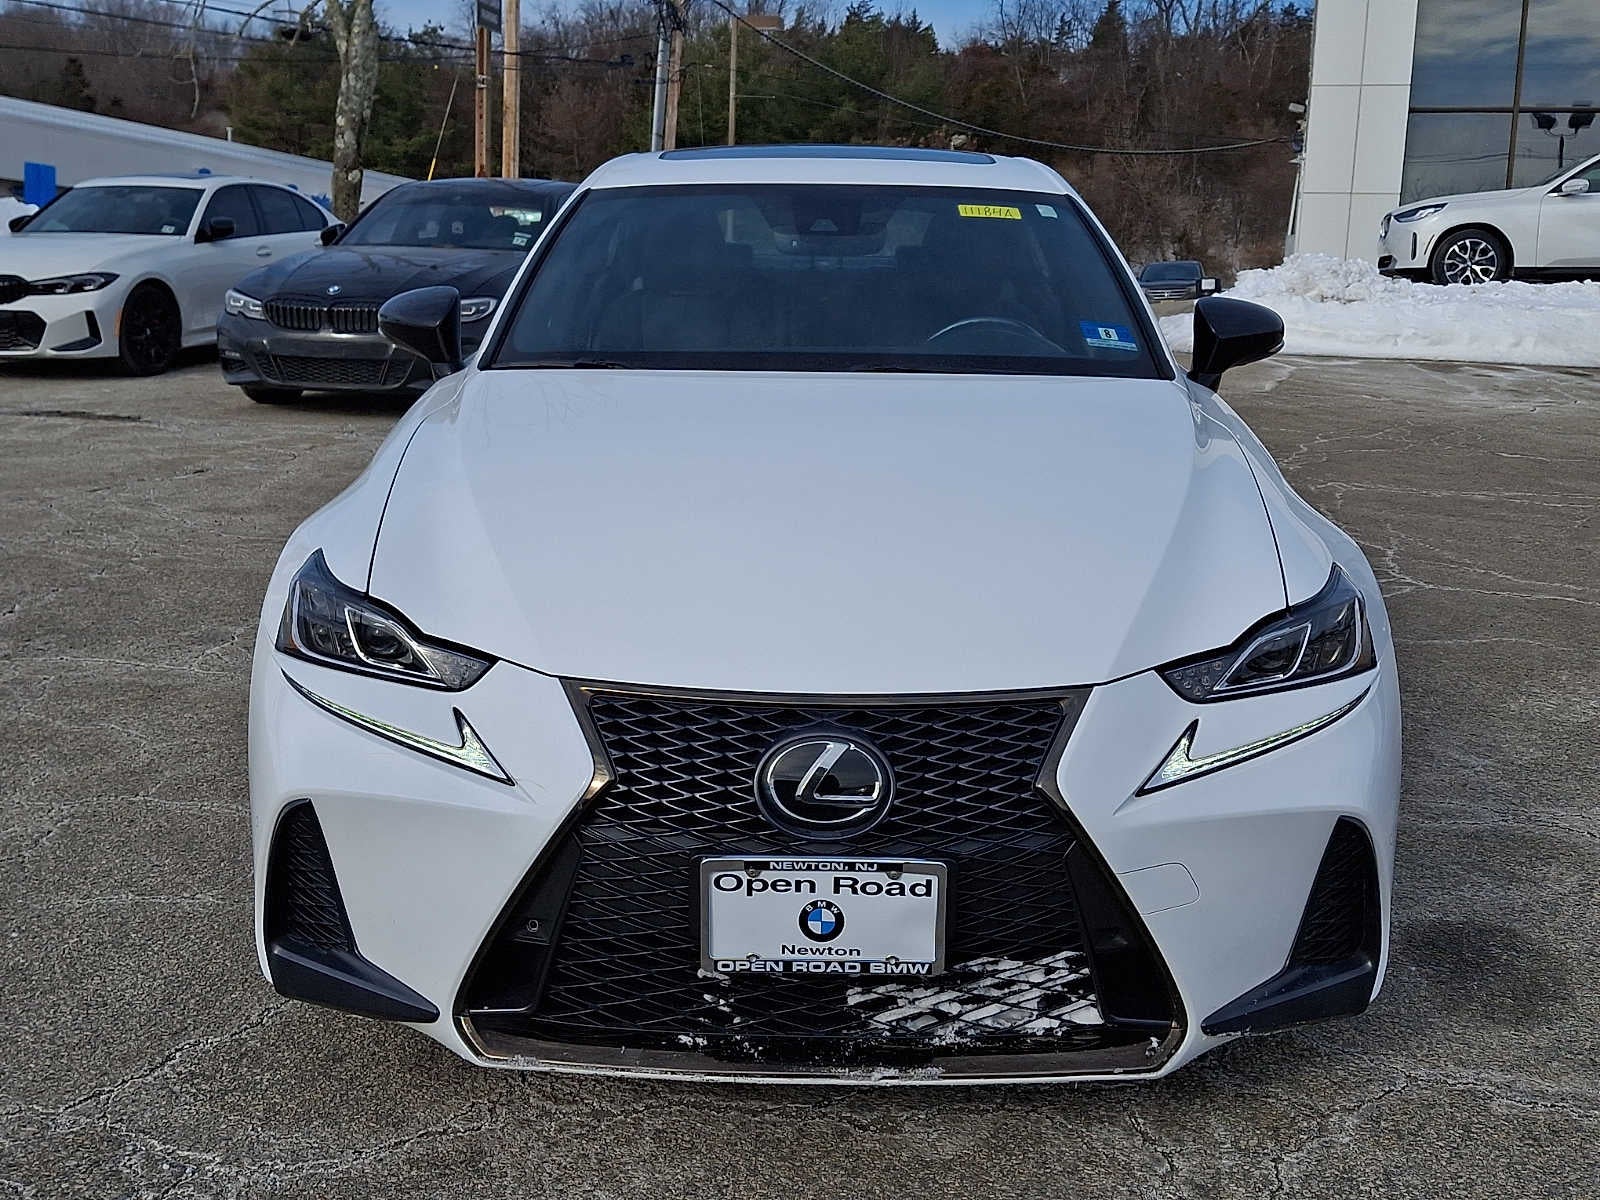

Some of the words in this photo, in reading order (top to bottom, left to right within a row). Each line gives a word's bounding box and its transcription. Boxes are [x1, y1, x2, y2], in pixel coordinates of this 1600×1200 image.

[1103, 329, 1112, 339] 8
[855, 862, 878, 872] NJ
[713, 873, 817, 897] Open
[832, 876, 933, 898] Road
[805, 901, 840, 914] BMW
[781, 944, 861, 957] Newton
[717, 960, 784, 972] OPEN
[792, 961, 861, 973] ROAD
[869, 961, 930, 974] BMW
